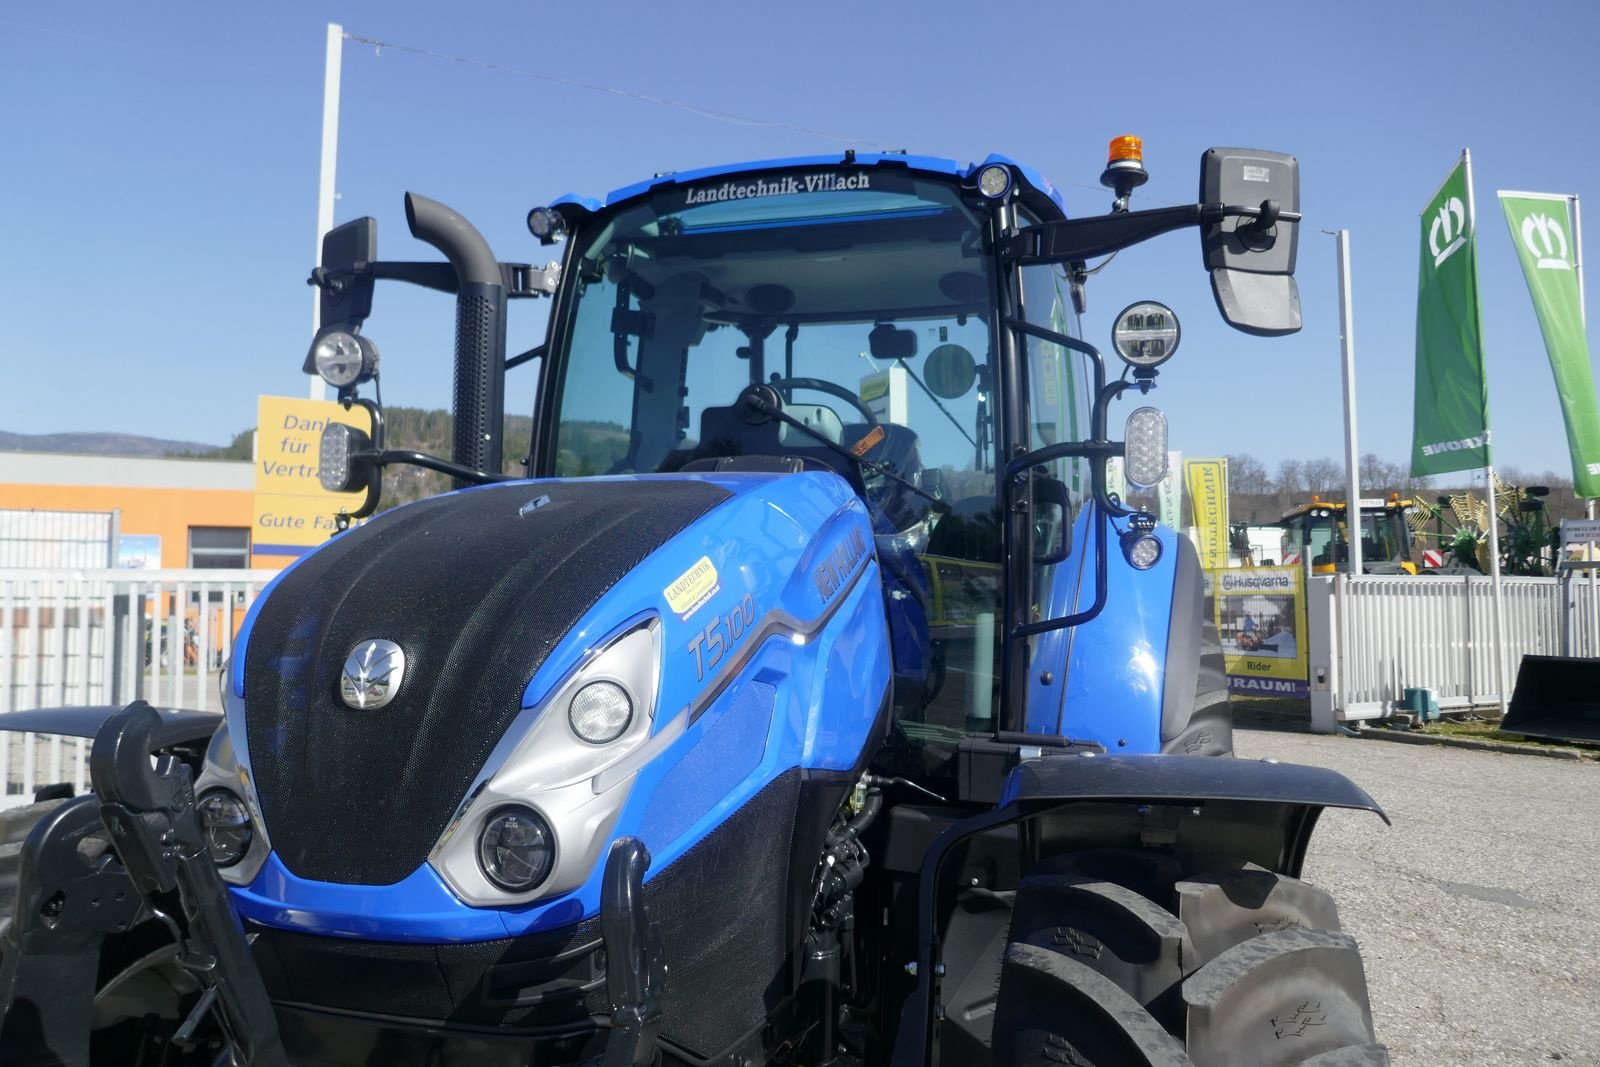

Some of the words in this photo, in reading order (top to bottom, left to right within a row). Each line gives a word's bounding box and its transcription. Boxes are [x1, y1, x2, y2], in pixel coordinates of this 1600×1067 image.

[684, 171, 870, 204] Landtechnik-Villach
[281, 437, 310, 454] für
[263, 460, 319, 478] Vertr
[259, 513, 304, 529] Gute
[313, 516, 337, 531] Fa
[667, 561, 711, 601] LANDTECHNIK
[1234, 575, 1289, 589] Husqvarna
[688, 592, 756, 682] T5.100
[1247, 661, 1272, 671] Rider
[1227, 677, 1296, 692] RAUM!
